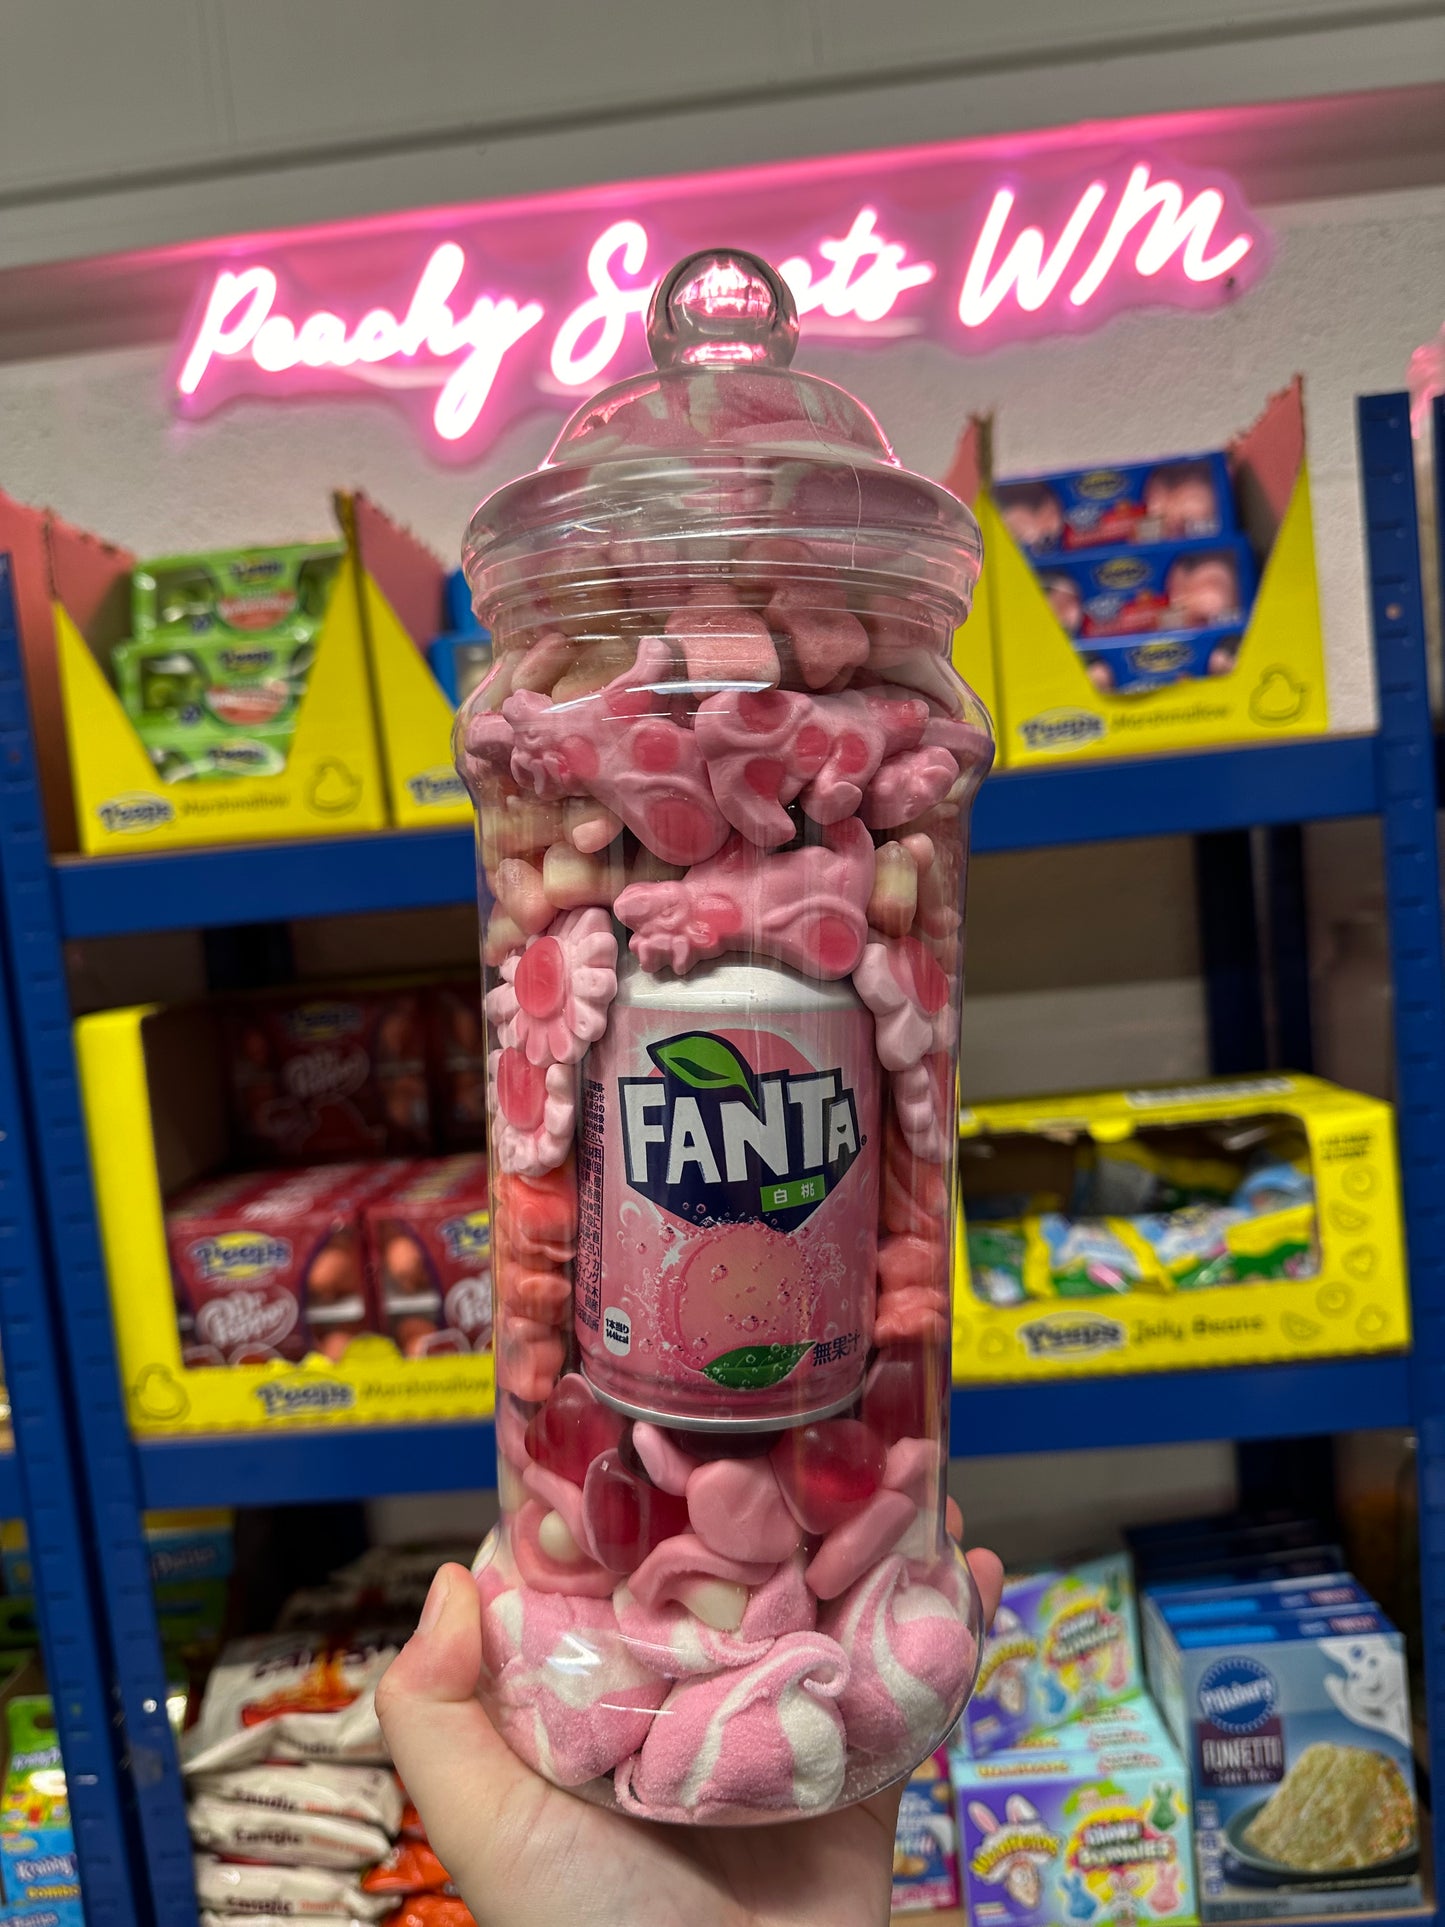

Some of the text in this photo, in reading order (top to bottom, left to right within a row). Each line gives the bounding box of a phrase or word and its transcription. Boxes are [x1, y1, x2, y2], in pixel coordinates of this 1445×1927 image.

[177, 241, 546, 440] Peachy
[550, 218, 937, 387] Sets
[623, 1076, 857, 1185] FANTA
[813, 1329, 861, 1367] 無果汁
